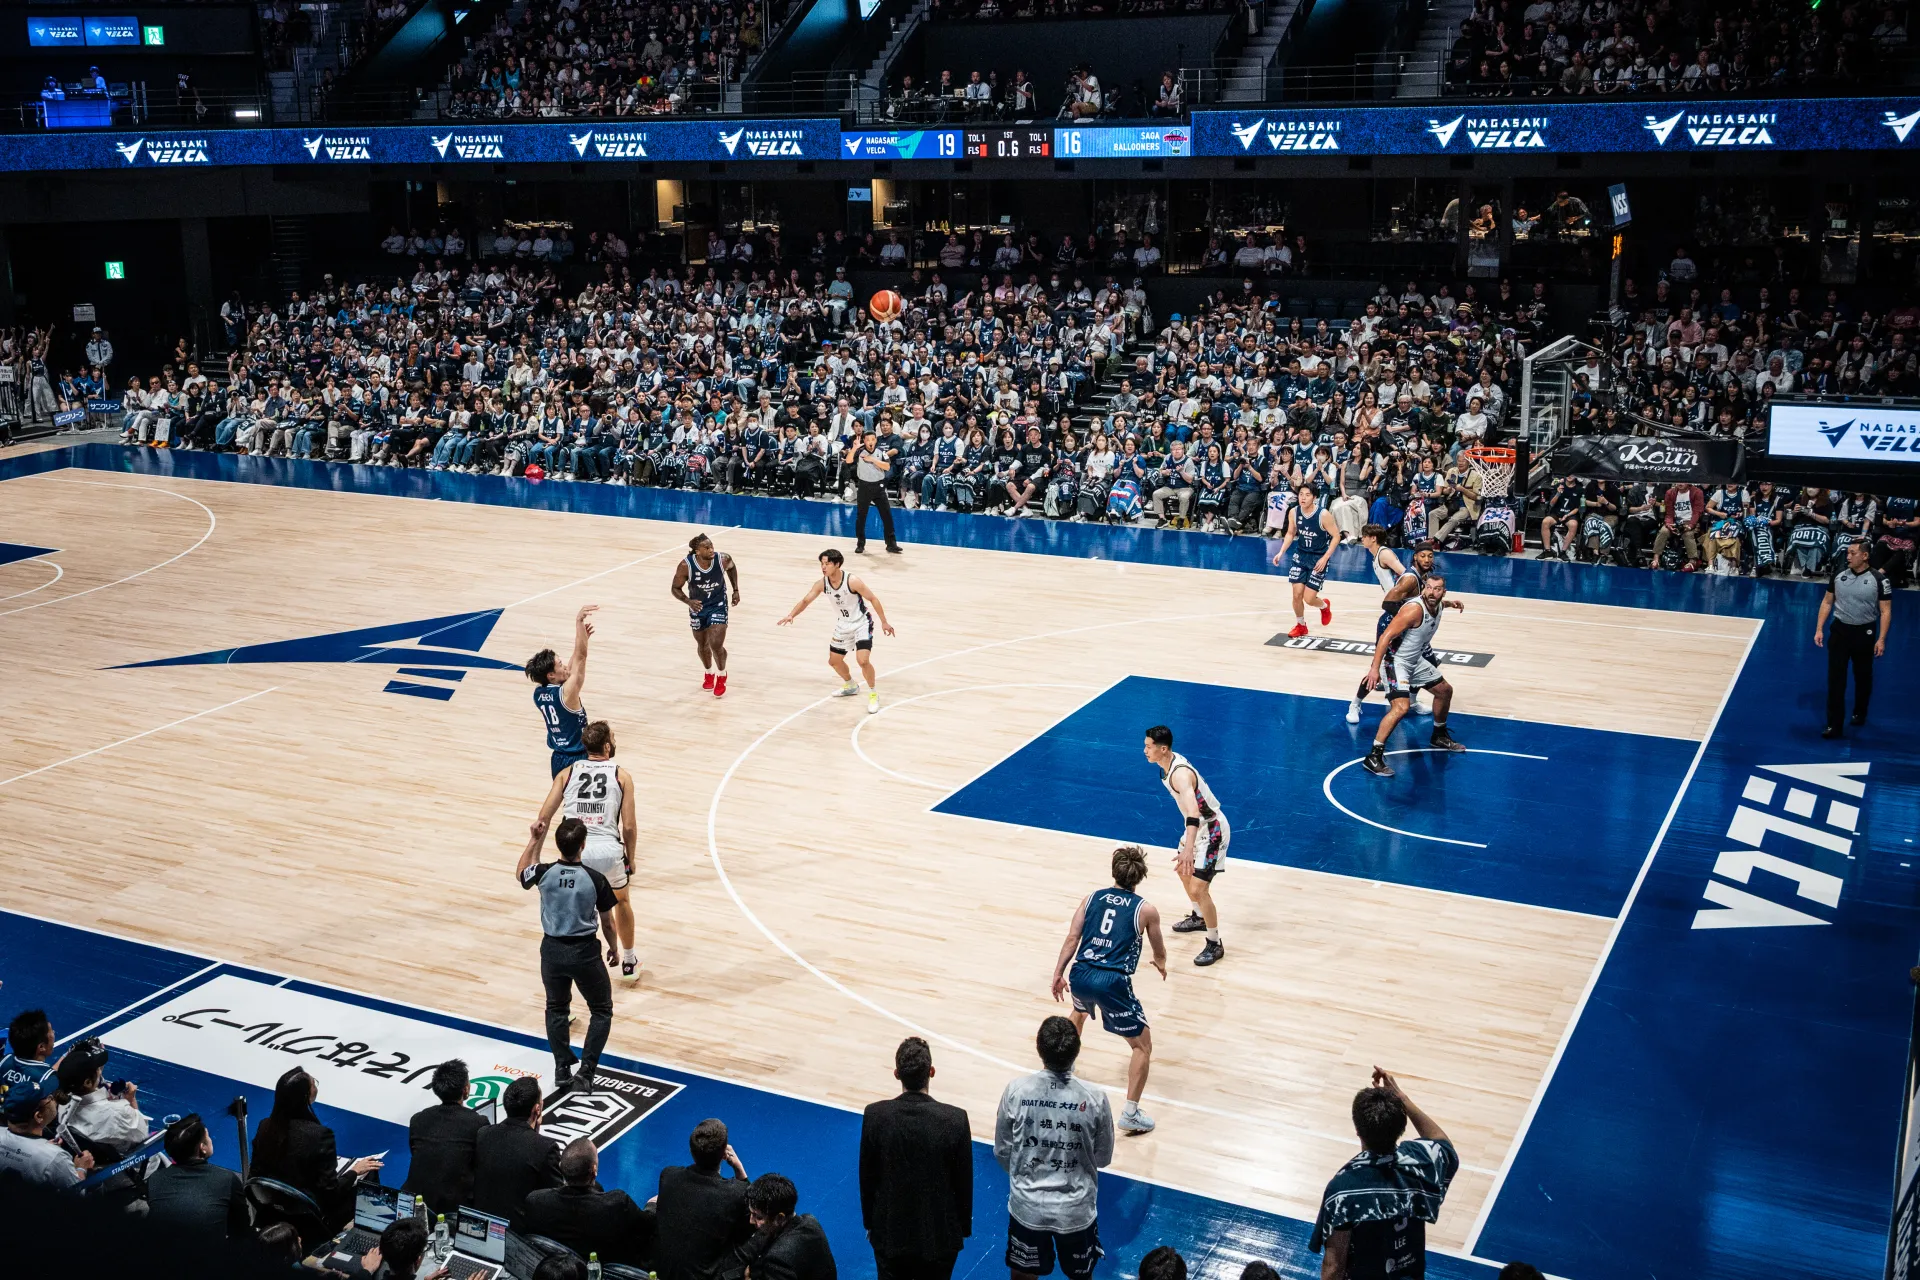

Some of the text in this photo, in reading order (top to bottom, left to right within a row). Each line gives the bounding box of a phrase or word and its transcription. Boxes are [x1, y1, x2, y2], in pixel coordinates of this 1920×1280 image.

[1467, 117, 1547, 129] NAGASAKI
[1688, 113, 1776, 125] NAGASAKI
[1267, 121, 1340, 132] NAGASAKI
[325, 136, 370, 145] NAGASAKI
[454, 135, 503, 144] NAGASAKI
[594, 132, 647, 141] NAGASAKI
[746, 130, 803, 139] NAGASAKI
[866, 136, 898, 145] NAGASAKI
[968, 133, 986, 142] TOL 1
[1003, 131, 1013, 139] 1ST
[1029, 133, 1047, 142] TOL 1
[1140, 132, 1160, 141] SAGA
[1467, 131, 1546, 148] VELCA
[1688, 127, 1774, 145] VELCA
[147, 139, 208, 148] NAGASAKI
[937, 133, 955, 156] 19
[1063, 131, 1081, 154] 16
[1113, 142, 1160, 152] BALLOONERS
[1267, 133, 1339, 150] VELCA
[325, 146, 371, 160] VELCA
[455, 145, 504, 159] VELCA
[595, 143, 648, 157] VELCA
[747, 141, 803, 156] VELCA
[866, 146, 886, 155] VELCA
[968, 146, 980, 155] FLS
[998, 140, 1019, 157] 0.6
[1029, 145, 1041, 154] FLS
[147, 150, 209, 163] VELCA
[1612, 193, 1628, 216] NSS
[55, 411, 84, 423] サニクリーン
[1860, 422, 1920, 434] NAGAS
[1618, 444, 1699, 466] Koun
[1564, 498, 1570, 508] 7
[577, 772, 608, 800] 23
[576, 802, 606, 814] DUDZINSKI
[1691, 762, 1871, 929] VELCA
[559, 878, 576, 889] 113
[1100, 908, 1116, 935] 6
[1021, 1099, 1078, 1111] BOAT RACE 大村
[111, 1154, 147, 1175] STADIUM CITY
[1394, 1235, 1407, 1250] LEE
